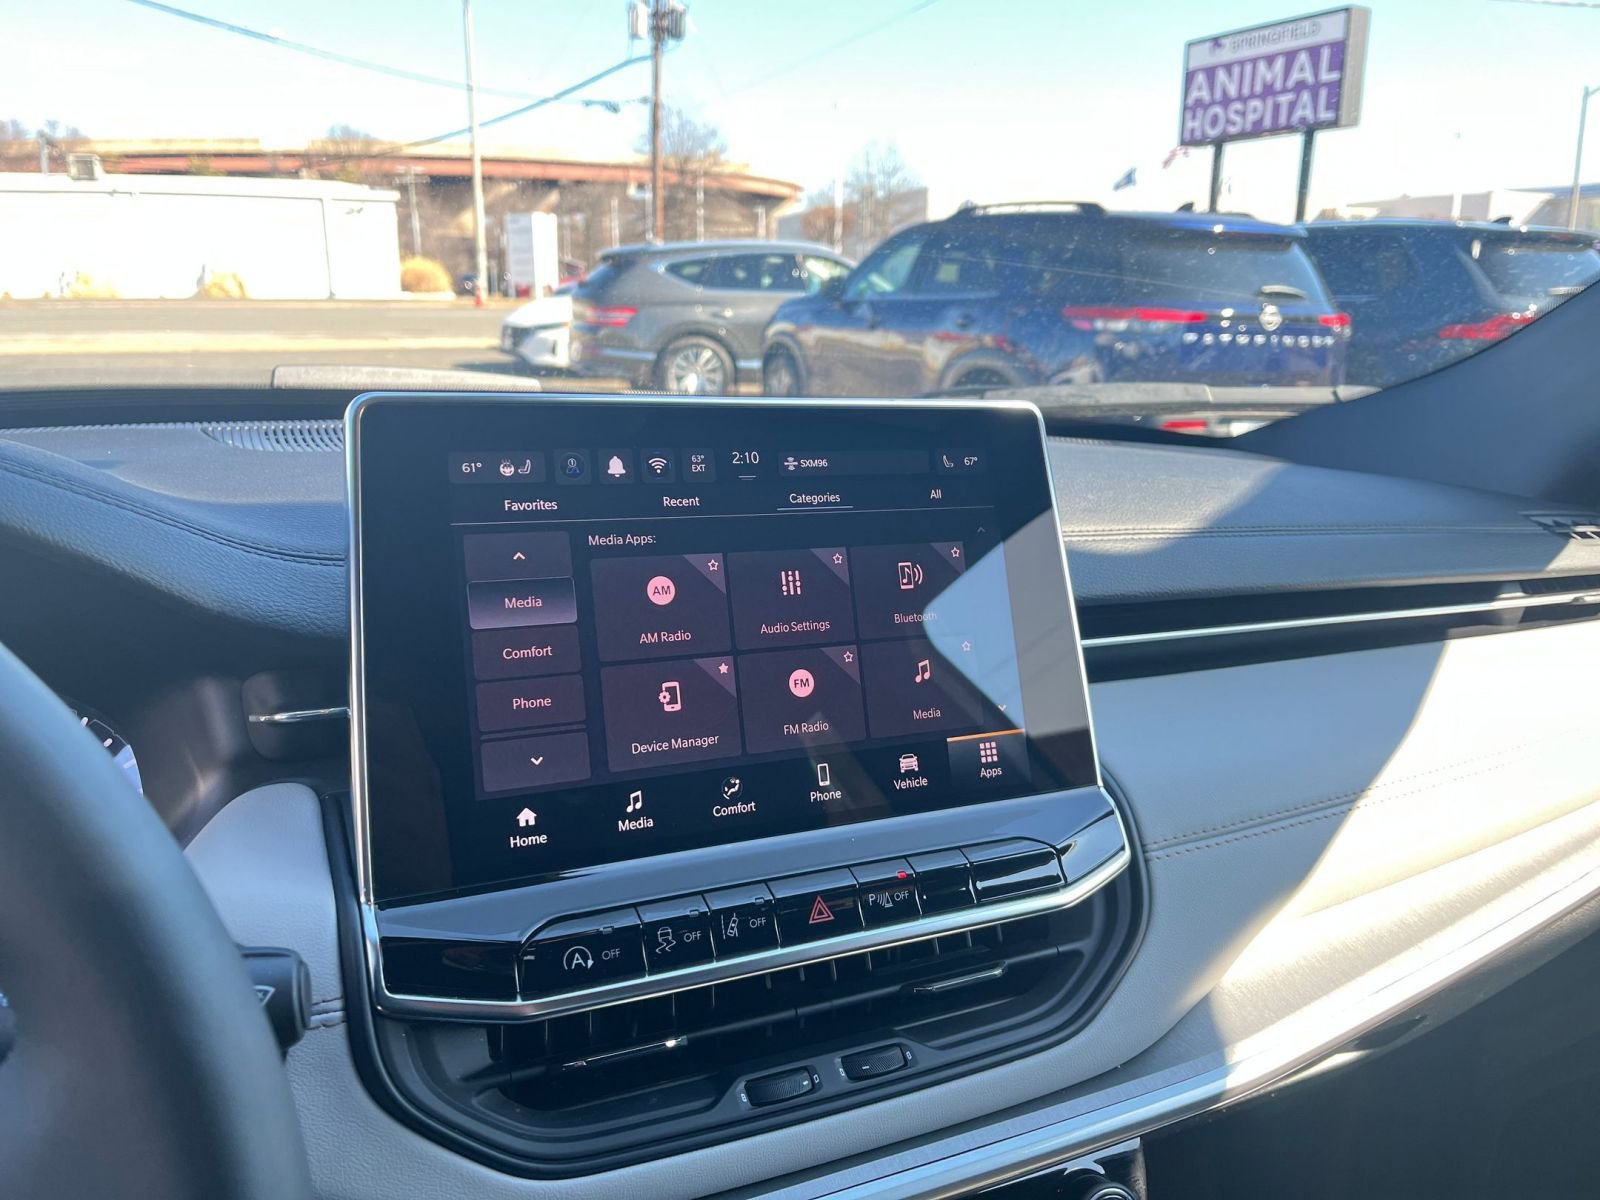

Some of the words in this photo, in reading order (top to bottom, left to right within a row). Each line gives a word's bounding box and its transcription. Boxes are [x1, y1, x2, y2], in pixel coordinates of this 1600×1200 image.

[1185, 44, 1341, 107] ANIMAL
[1183, 86, 1336, 142] HOSPITAL
[732, 451, 760, 465] 2:10
[800, 458, 828, 468] SXM96
[691, 463, 706, 473] EXT
[789, 492, 841, 504] Categories
[930, 489, 942, 500] All
[504, 499, 558, 511] Favorites
[663, 496, 700, 507] Recent
[588, 534, 624, 546] Media
[625, 533, 657, 546] Apps:
[652, 585, 671, 596] AM
[504, 595, 543, 609] Media
[894, 611, 938, 624] Bluetooth
[760, 622, 790, 635] Audio
[791, 618, 831, 632] Settings
[639, 631, 658, 644] AM
[661, 630, 692, 642] Radio
[503, 645, 553, 660] Comfort
[793, 678, 810, 689] FM
[512, 696, 552, 710] Phone
[913, 707, 941, 720] Media
[783, 723, 800, 735] FM
[801, 720, 829, 733] Radio
[631, 740, 670, 754] Device
[671, 734, 719, 750] Manager
[980, 766, 1002, 779] Apps
[893, 776, 928, 790] Vehicle
[810, 789, 842, 803] Phone
[712, 801, 756, 818] Comfort
[618, 817, 654, 832] Media
[510, 833, 548, 849] Home
[893, 890, 910, 901] OFF
[749, 917, 767, 929] OFF
[683, 930, 702, 943] OFF
[601, 948, 621, 961] OFF
